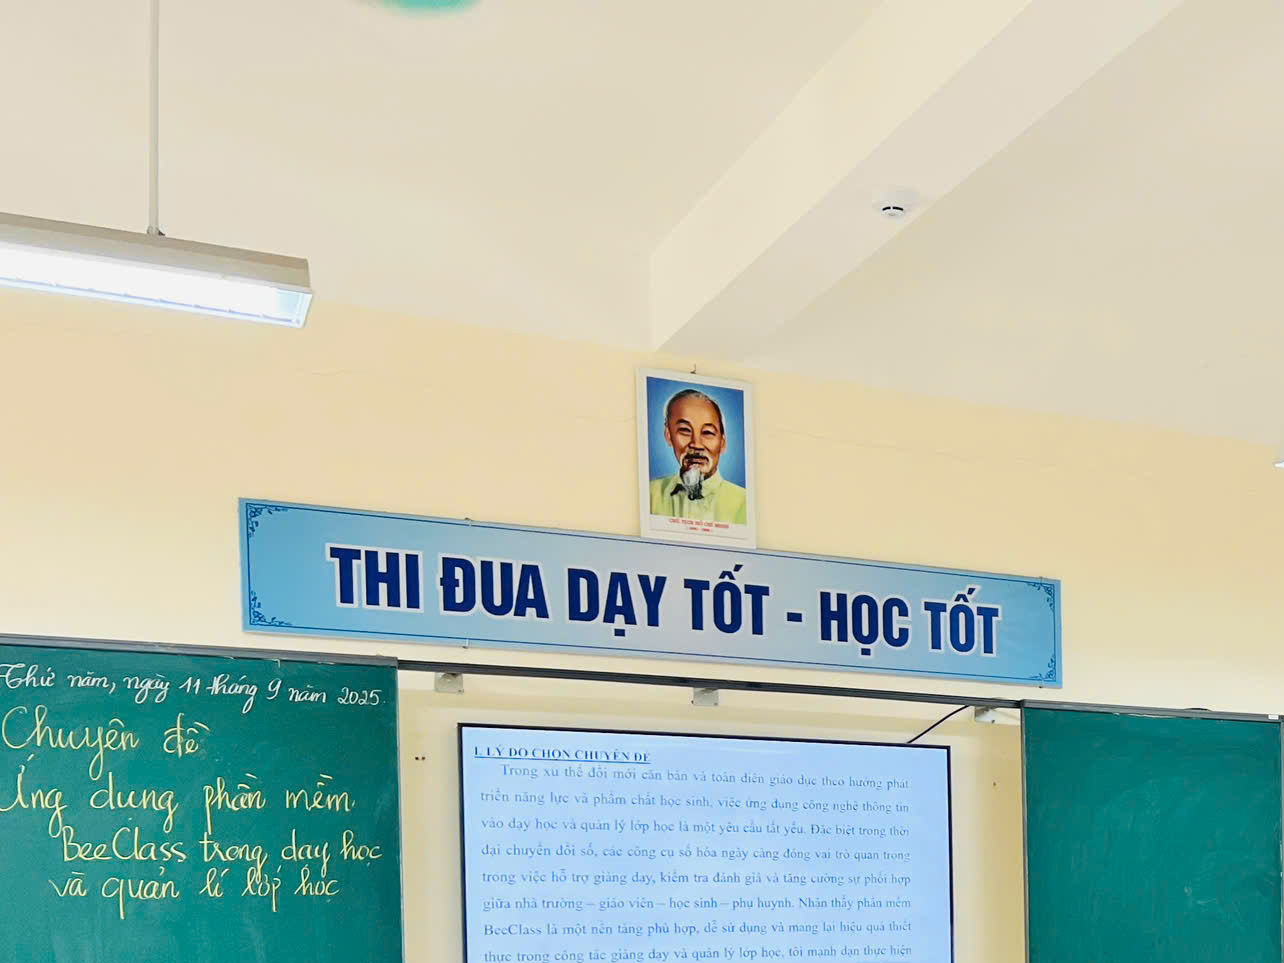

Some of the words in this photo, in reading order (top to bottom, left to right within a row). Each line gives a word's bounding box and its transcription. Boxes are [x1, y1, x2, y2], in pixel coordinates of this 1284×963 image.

[330, 546, 420, 610] THI
[440, 556, 550, 618] ĐUA
[568, 568, 667, 637] DẠY
[684, 564, 770, 635] TỐT
[820, 591, 910, 656] HỌC
[924, 587, 1000, 654] TỐT
[0, 663, 56, 688] Thứ
[123, 673, 170, 704] ngày
[178, 677, 200, 694] 11
[206, 673, 258, 714] tháng
[266, 678, 282, 700] 9
[288, 684, 326, 704] năm
[2, 704, 140, 780] Chuyên
[163, 712, 210, 758] đề
[509, 748, 529, 758] DO
[501, 764, 538, 780] Trong
[544, 768, 558, 778] xu
[0, 754, 68, 838] Ứng
[203, 773, 266, 836] phần
[536, 818, 557, 832] học
[654, 820, 674, 833] học
[62, 826, 187, 862] BeeClass
[198, 831, 268, 884] trong
[340, 830, 382, 868] học
[482, 872, 516, 885] trong
[694, 874, 708, 884] tra
[102, 866, 180, 920] quản
[242, 865, 282, 912] lớp
[294, 867, 340, 902] học
[670, 897, 690, 911] học
[694, 898, 718, 908] sinh
[484, 924, 542, 936] BeeClass
[789, 924, 818, 936] mang
[517, 952, 550, 963] trong
